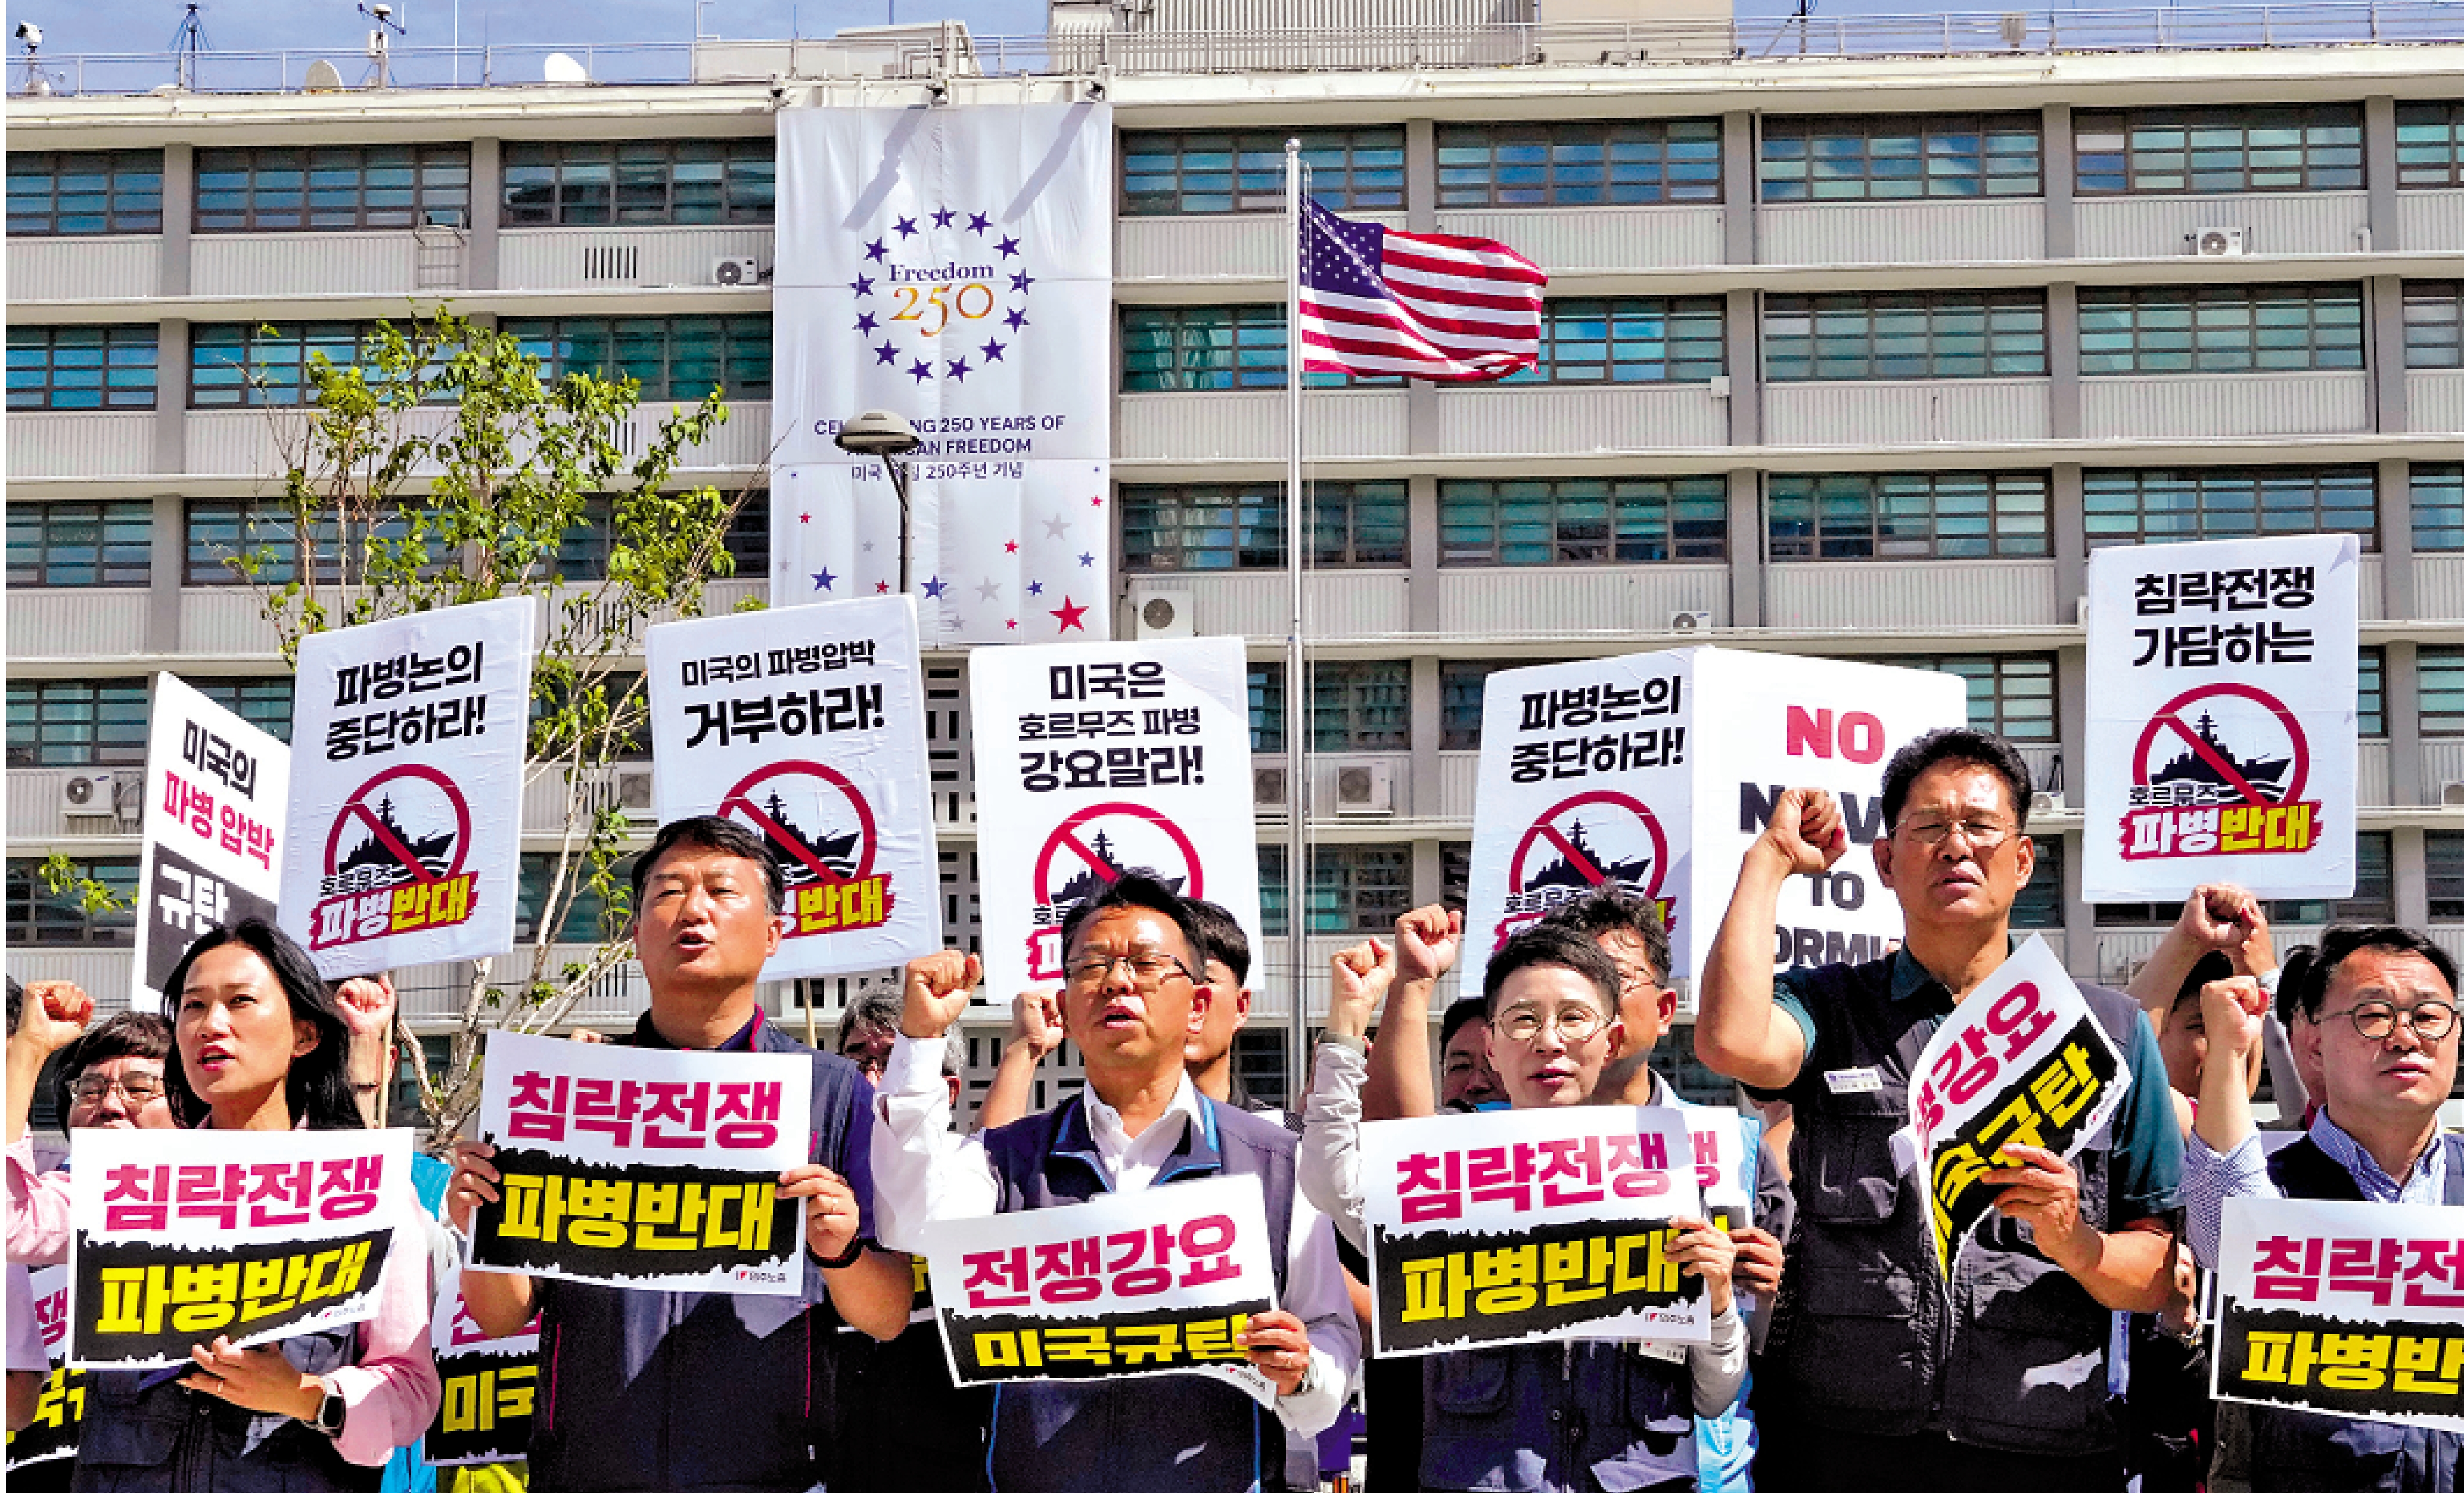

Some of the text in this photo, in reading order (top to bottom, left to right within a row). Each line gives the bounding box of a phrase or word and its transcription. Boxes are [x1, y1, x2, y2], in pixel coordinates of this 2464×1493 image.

[888, 262, 994, 281] Freedom
[890, 283, 994, 337] 250
[940, 417, 973, 433] 250
[979, 415, 1036, 431] YEARS
[1042, 415, 1066, 430] OF
[946, 438, 1031, 454] FREEDOM
[2135, 566, 2314, 616] 침략전쟁
[682, 638, 876, 686] 미국의 파병압박
[2133, 622, 2314, 667] 가담하는
[334, 641, 484, 707] 파병논의
[1051, 662, 1166, 702] 미국은
[327, 694, 486, 761] 중단하라!
[683, 682, 885, 749] 거부하라!
[1018, 706, 1201, 741] 호르무즈 파병
[1520, 675, 1682, 732] 파병논의
[182, 718, 257, 802] 미국의
[1511, 726, 1686, 783] 중단하라!
[1786, 705, 1885, 765] NO
[1021, 745, 1204, 793] 강요말라!
[163, 770, 275, 872] 파병 압박
[2130, 803, 2310, 855] 파병반대
[317, 875, 470, 944] 파병반대
[1808, 871, 1865, 910] TO
[508, 1070, 782, 1150] 침략전쟁
[104, 1154, 384, 1232] 침략전쟁
[1397, 1132, 1671, 1225] 침략전쟁
[497, 1173, 776, 1252] 파병반대
[95, 1240, 372, 1334] 파병반대
[962, 1213, 1242, 1309] 전쟁강요
[1401, 1229, 1679, 1323] 파병반대
